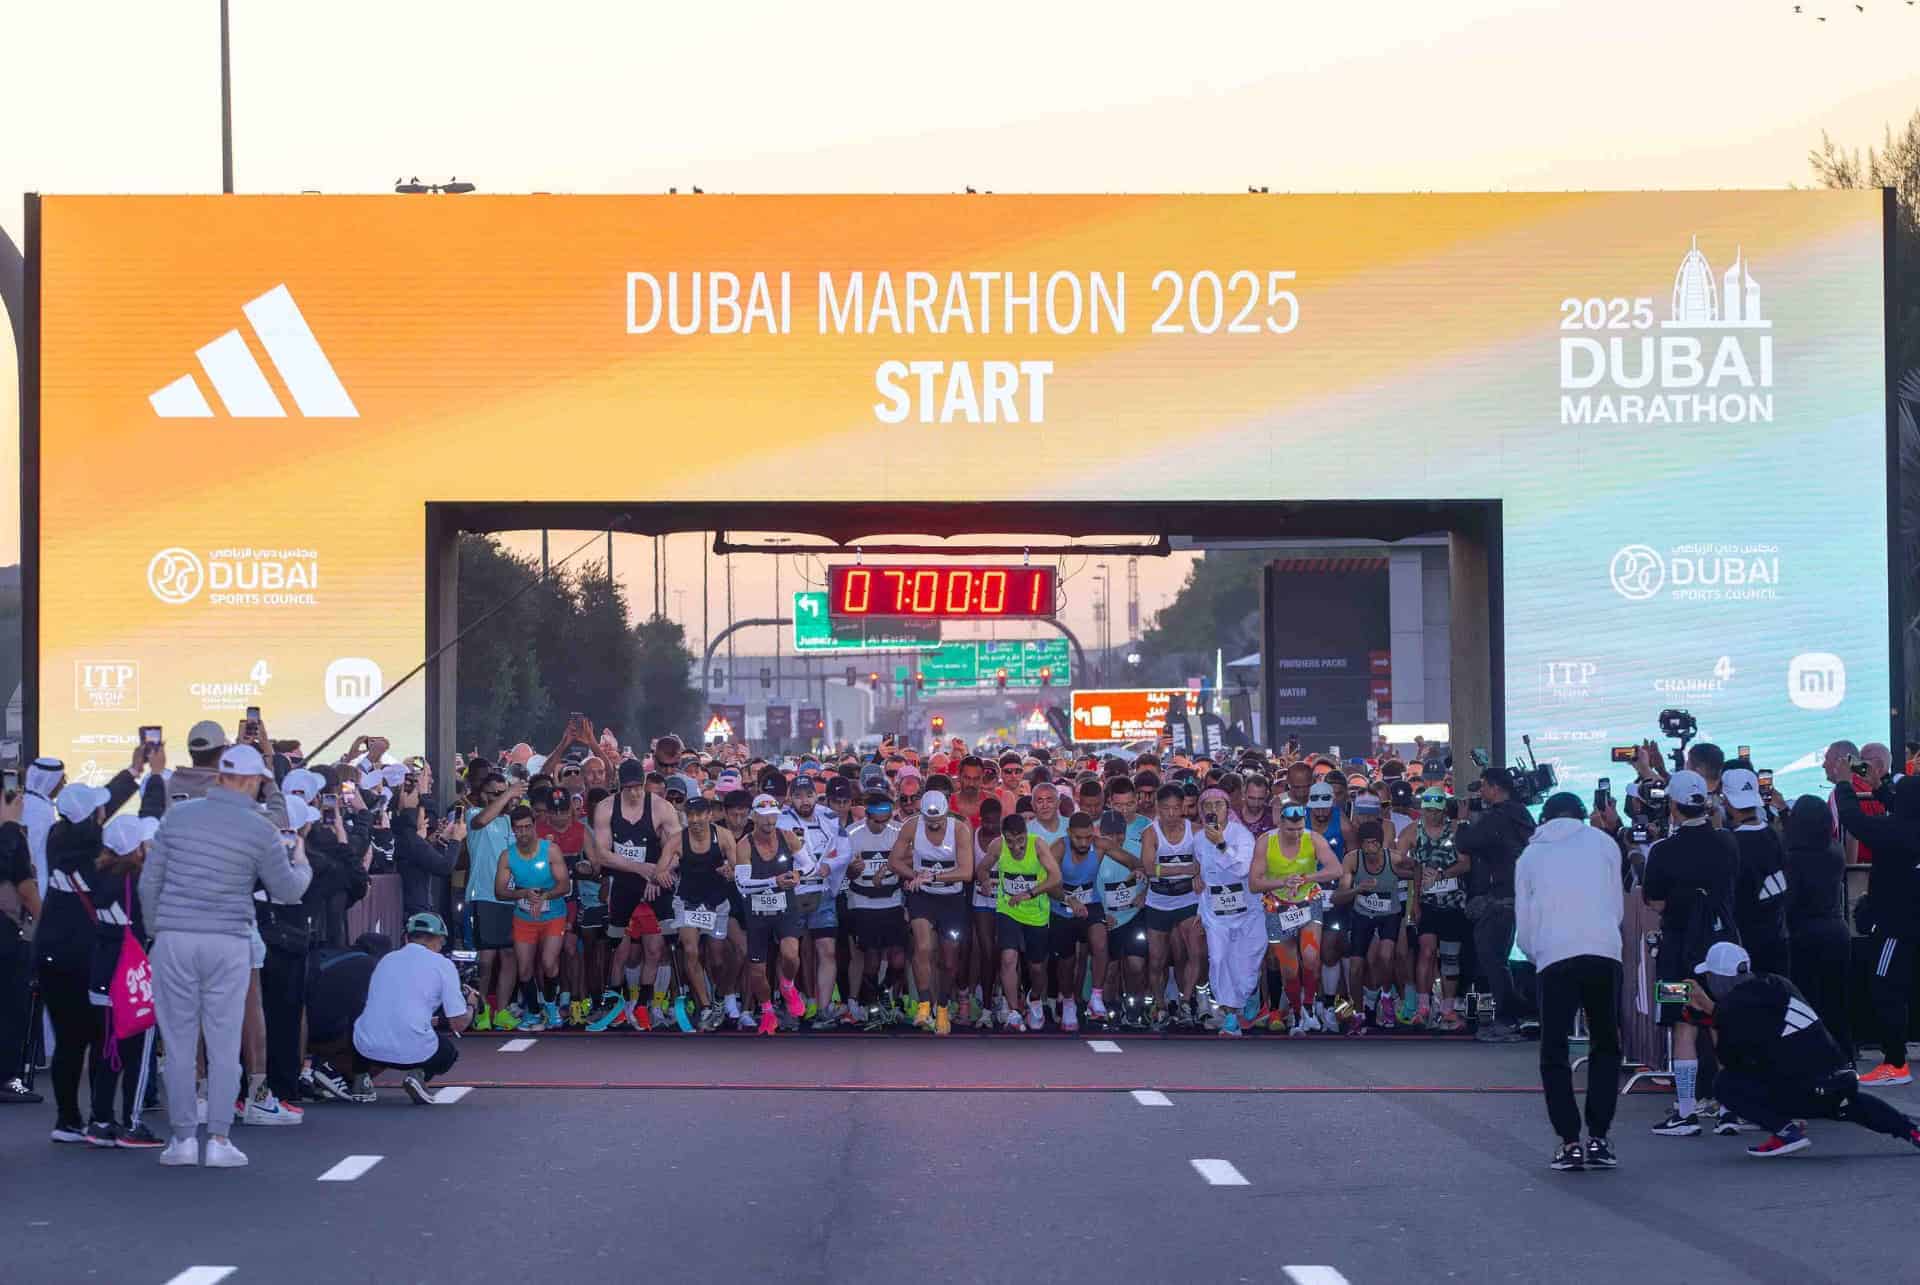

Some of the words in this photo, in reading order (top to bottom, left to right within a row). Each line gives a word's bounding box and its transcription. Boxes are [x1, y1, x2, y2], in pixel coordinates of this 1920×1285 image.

[626, 272, 791, 335] DUBAI
[818, 272, 1126, 334] MARATHON
[1151, 270, 1299, 334] 2025
[1560, 297, 1654, 330] 2025
[1560, 336, 1773, 389] DUBAI
[874, 359, 1054, 424] START
[1560, 394, 1774, 424] MARATHON
[208, 561, 318, 589] DUBAI
[1671, 557, 1779, 585] DUBAI
[209, 593, 260, 606] SPORTS
[263, 593, 319, 605] COUNCIL
[1672, 589, 1721, 600] SPORTS
[1725, 589, 1777, 600] COUNCIL
[84, 664, 134, 689] ITP
[249, 658, 273, 686] 4
[1547, 662, 1598, 685] ITP
[1713, 655, 1736, 681] 4
[190, 682, 264, 696] CHANNEL
[1279, 687, 1307, 697] WATER
[1653, 679, 1725, 692] CHANNEL
[760, 895, 778, 905] 586
[691, 912, 712, 923] 2253
